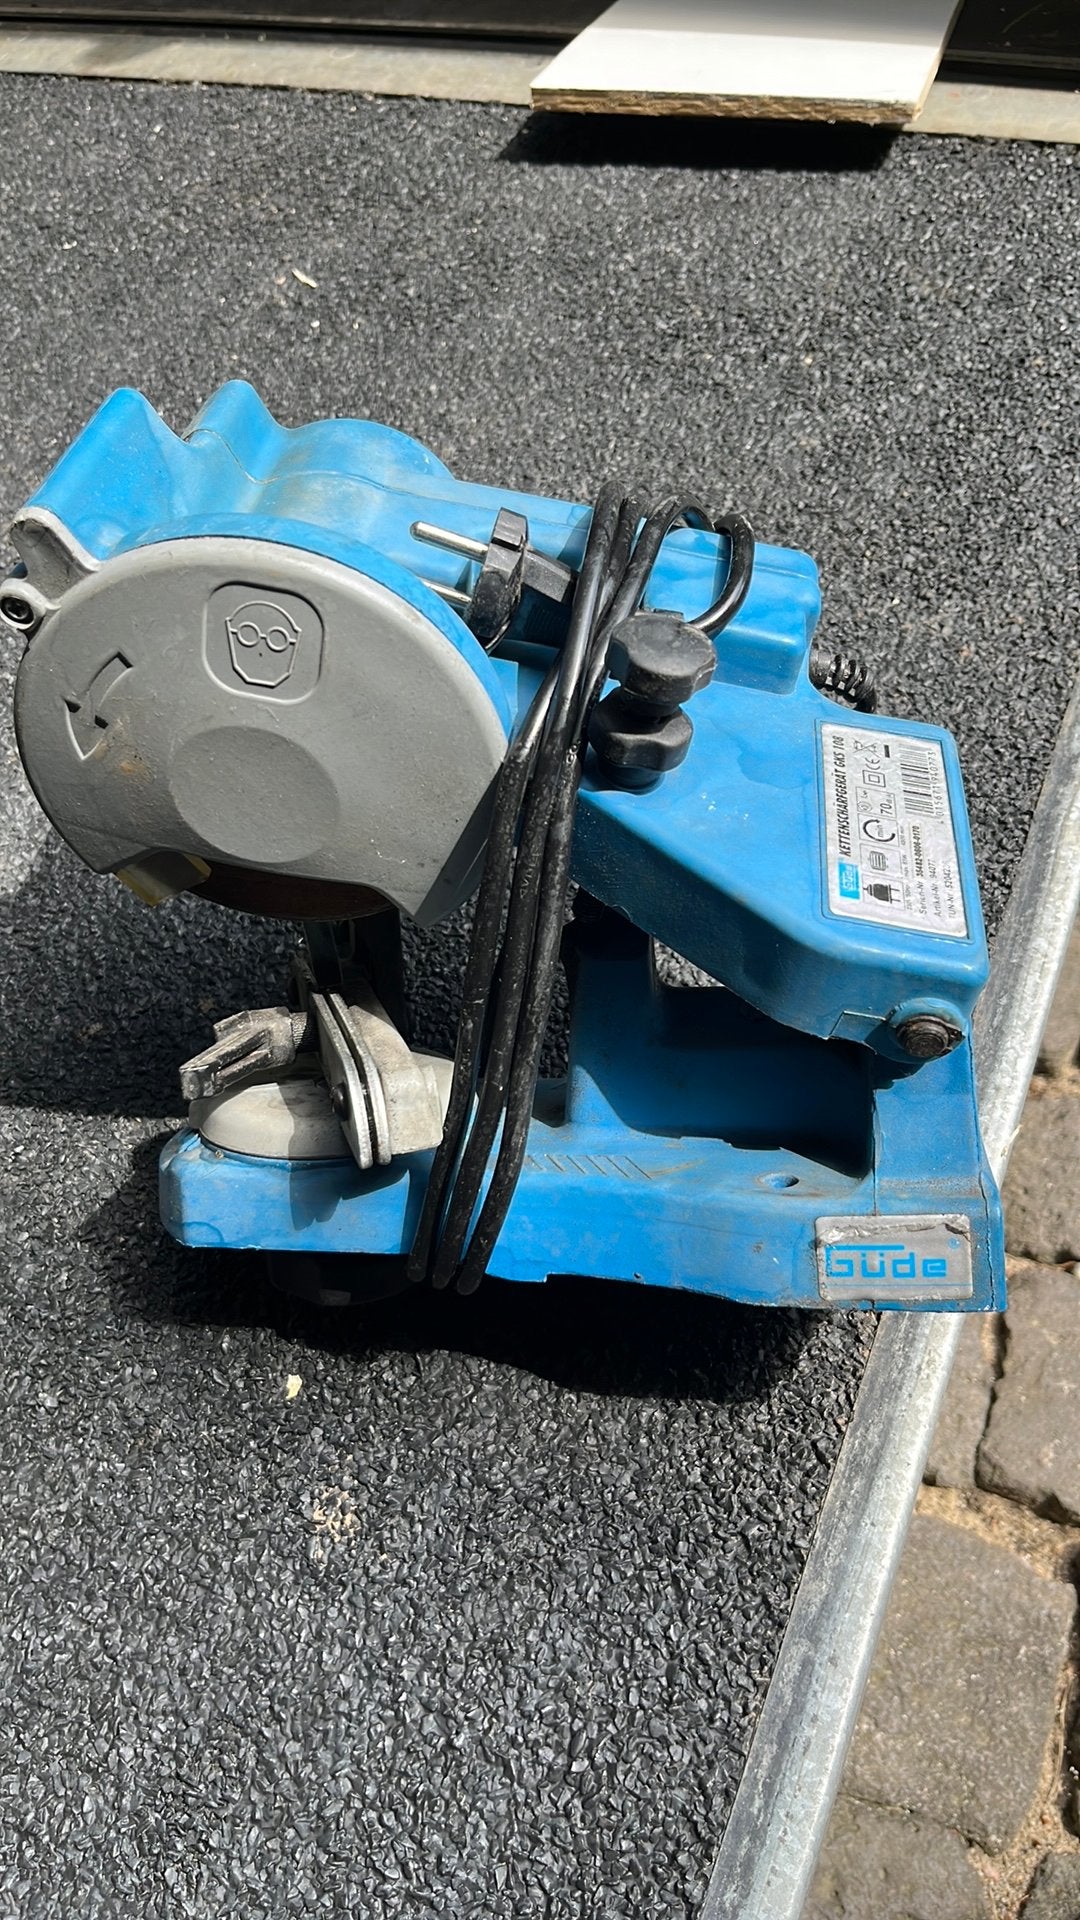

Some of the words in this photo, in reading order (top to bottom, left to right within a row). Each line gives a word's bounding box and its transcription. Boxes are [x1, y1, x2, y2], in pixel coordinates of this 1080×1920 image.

[831, 734, 844, 750] 108
[833, 751, 846, 768] GKS
[831, 768, 851, 857] KETTENSCHÄRFGERÄT
[825, 1244, 947, 1278] Güde
